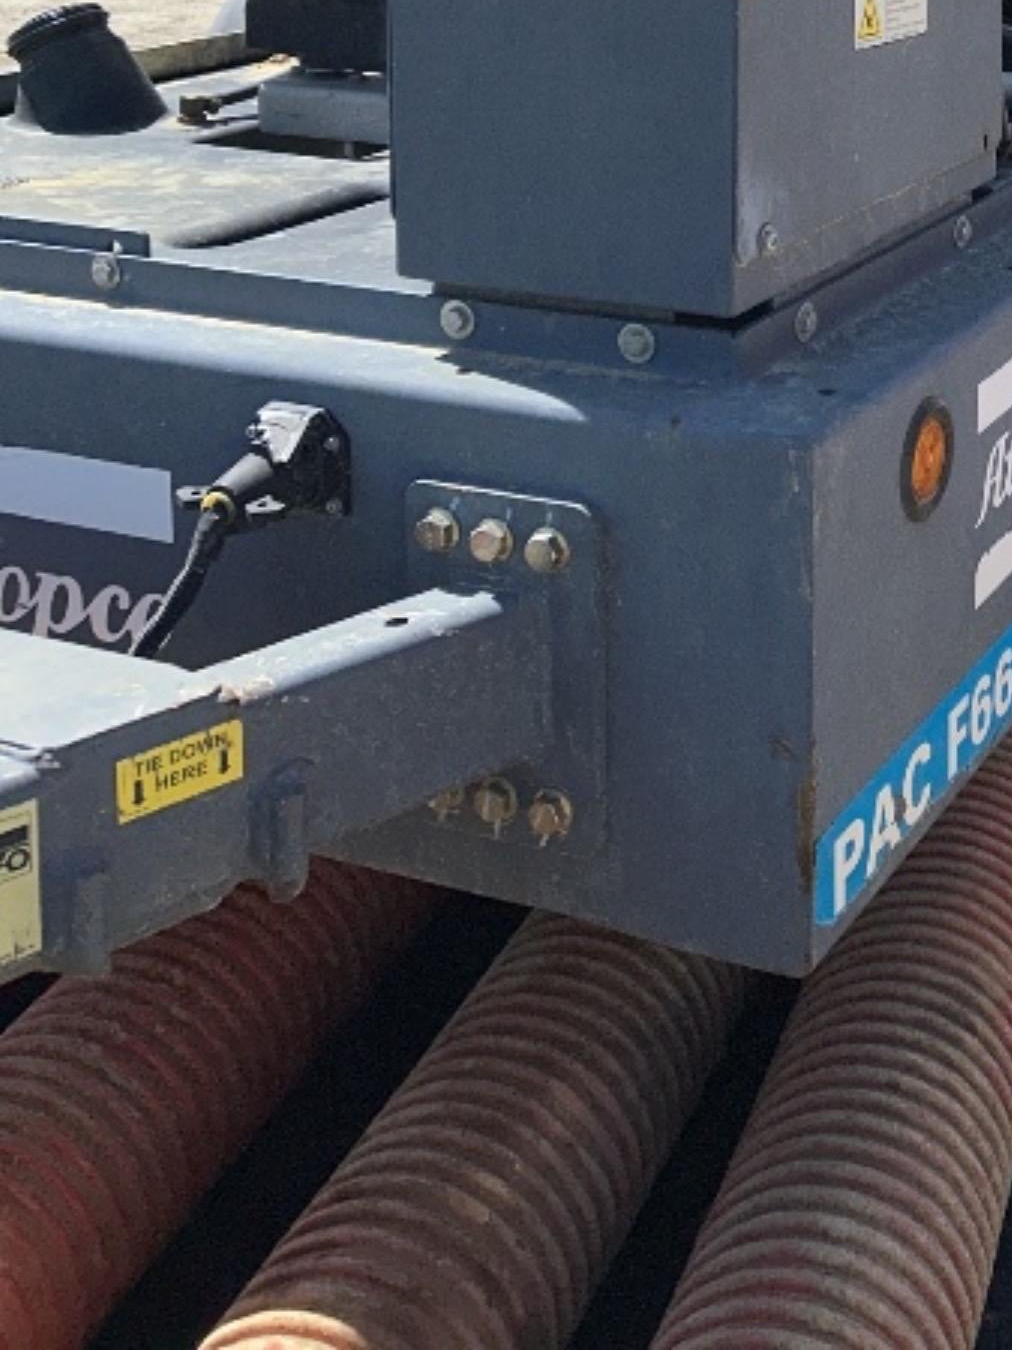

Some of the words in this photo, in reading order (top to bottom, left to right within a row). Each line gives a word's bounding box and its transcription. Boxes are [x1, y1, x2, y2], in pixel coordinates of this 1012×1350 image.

[136, 755, 163, 777] TIE
[169, 731, 228, 766] DOWN
[155, 759, 208, 792] HERE
[832, 742, 932, 916] PAC
